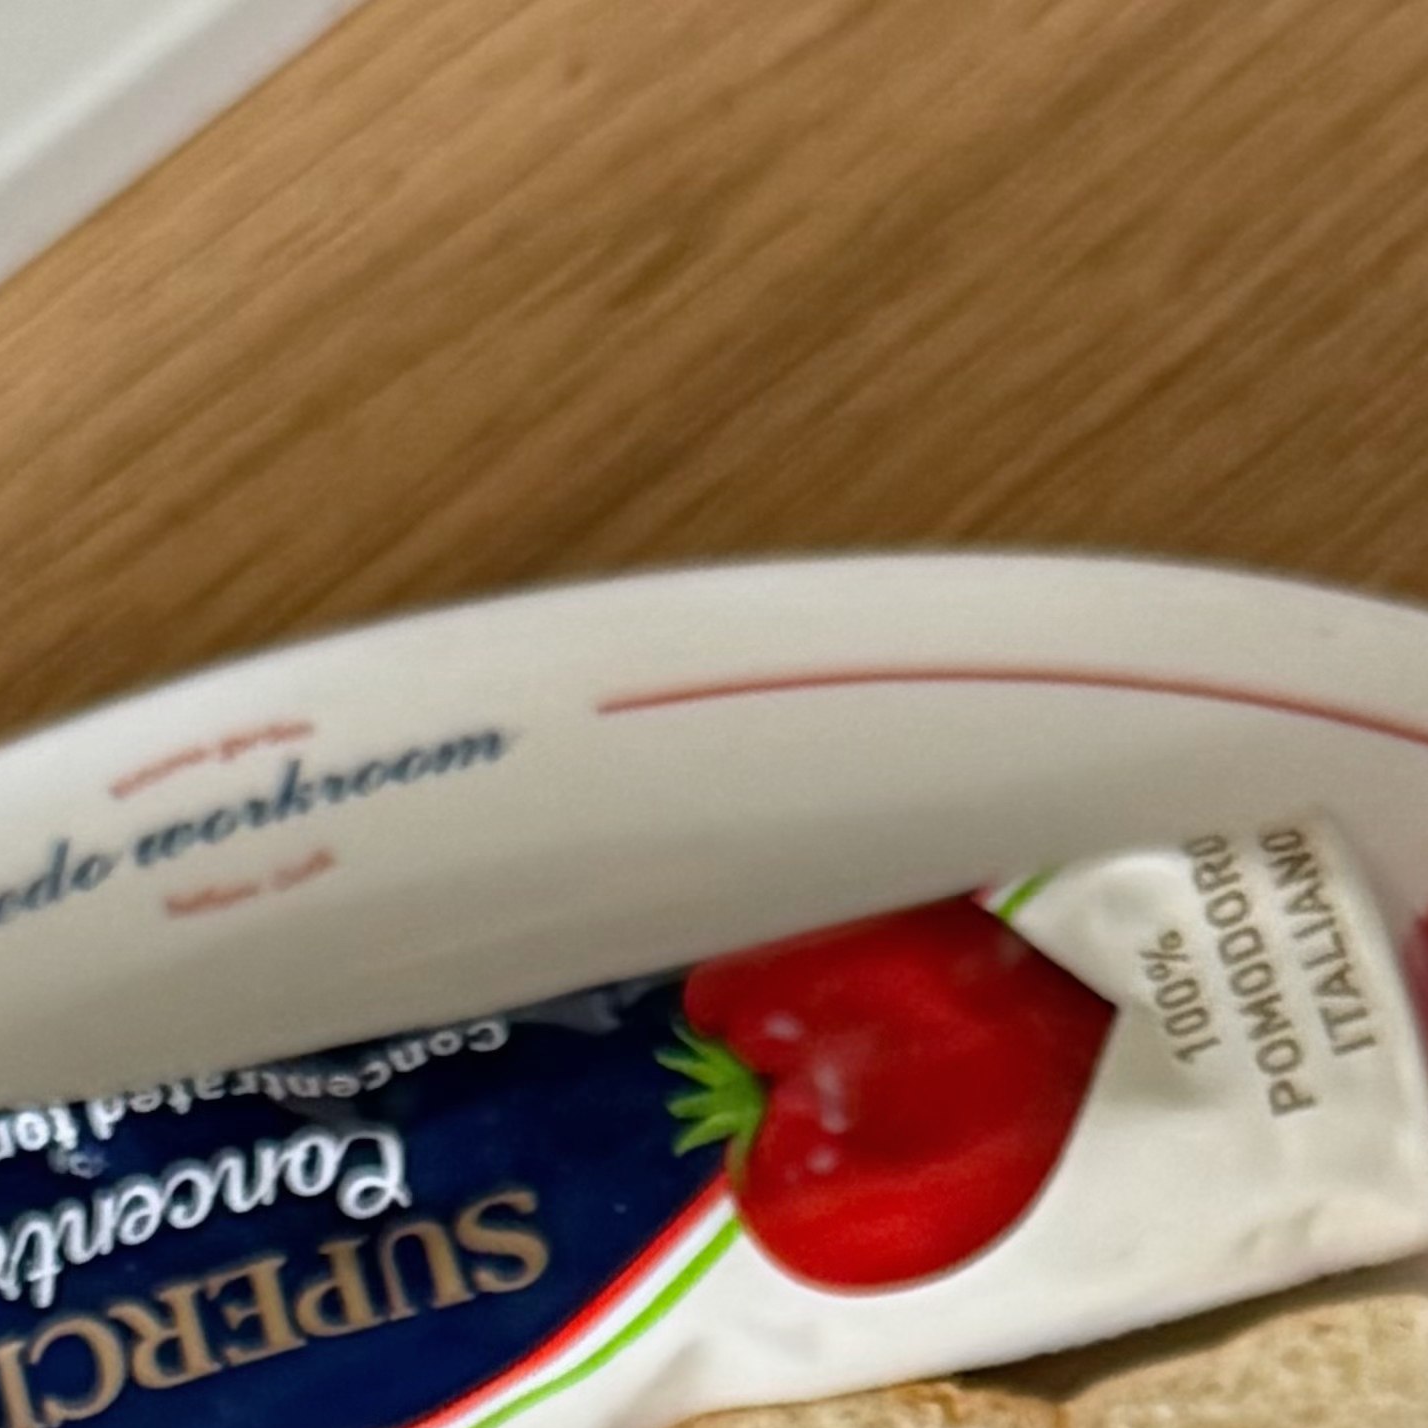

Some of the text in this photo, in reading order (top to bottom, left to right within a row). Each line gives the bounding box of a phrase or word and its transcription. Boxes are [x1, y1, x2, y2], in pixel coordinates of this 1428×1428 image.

[134, 729, 509, 866] workroom
[1139, 929, 1223, 1064] 100%
[1184, 833, 1319, 1117] POMODORO
[1258, 827, 1378, 1057] ITALIANO
